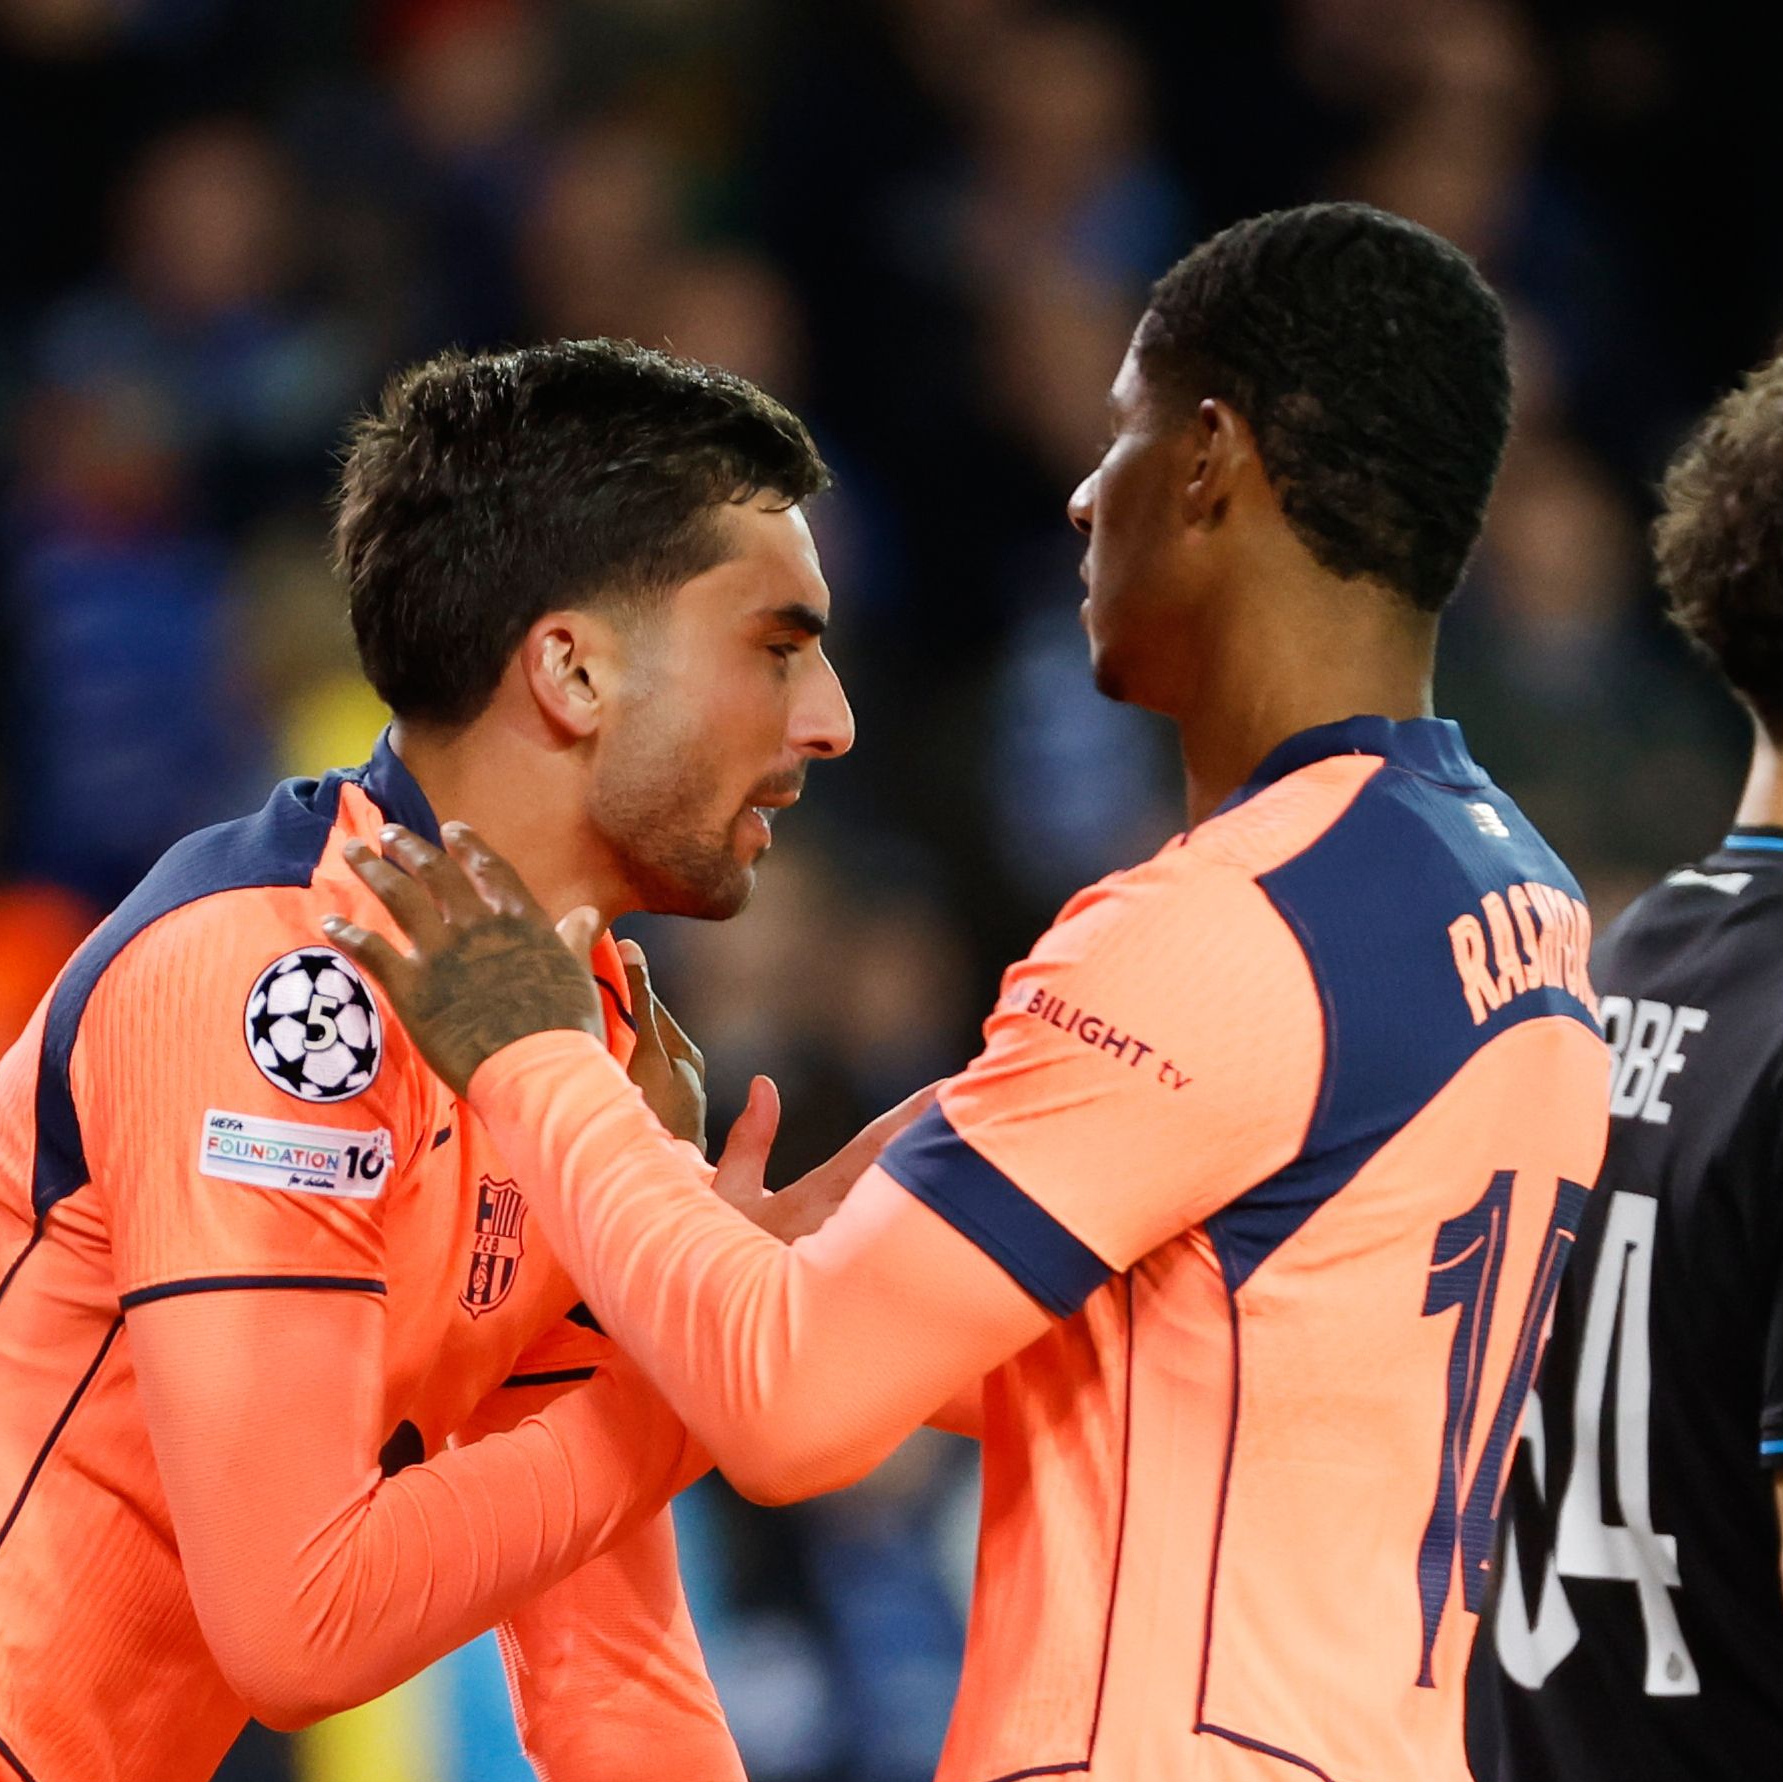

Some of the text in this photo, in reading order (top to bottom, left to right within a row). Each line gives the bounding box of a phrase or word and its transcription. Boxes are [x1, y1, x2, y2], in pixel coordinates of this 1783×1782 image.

[302, 993, 339, 1052] 5
[1024, 988, 1193, 1090] BILIGHT tv
[1600, 996, 1709, 1124] BBE
[210, 1115, 243, 1131] UEFA
[207, 1136, 339, 1171] FOUNDATION
[344, 1145, 385, 1180] 10
